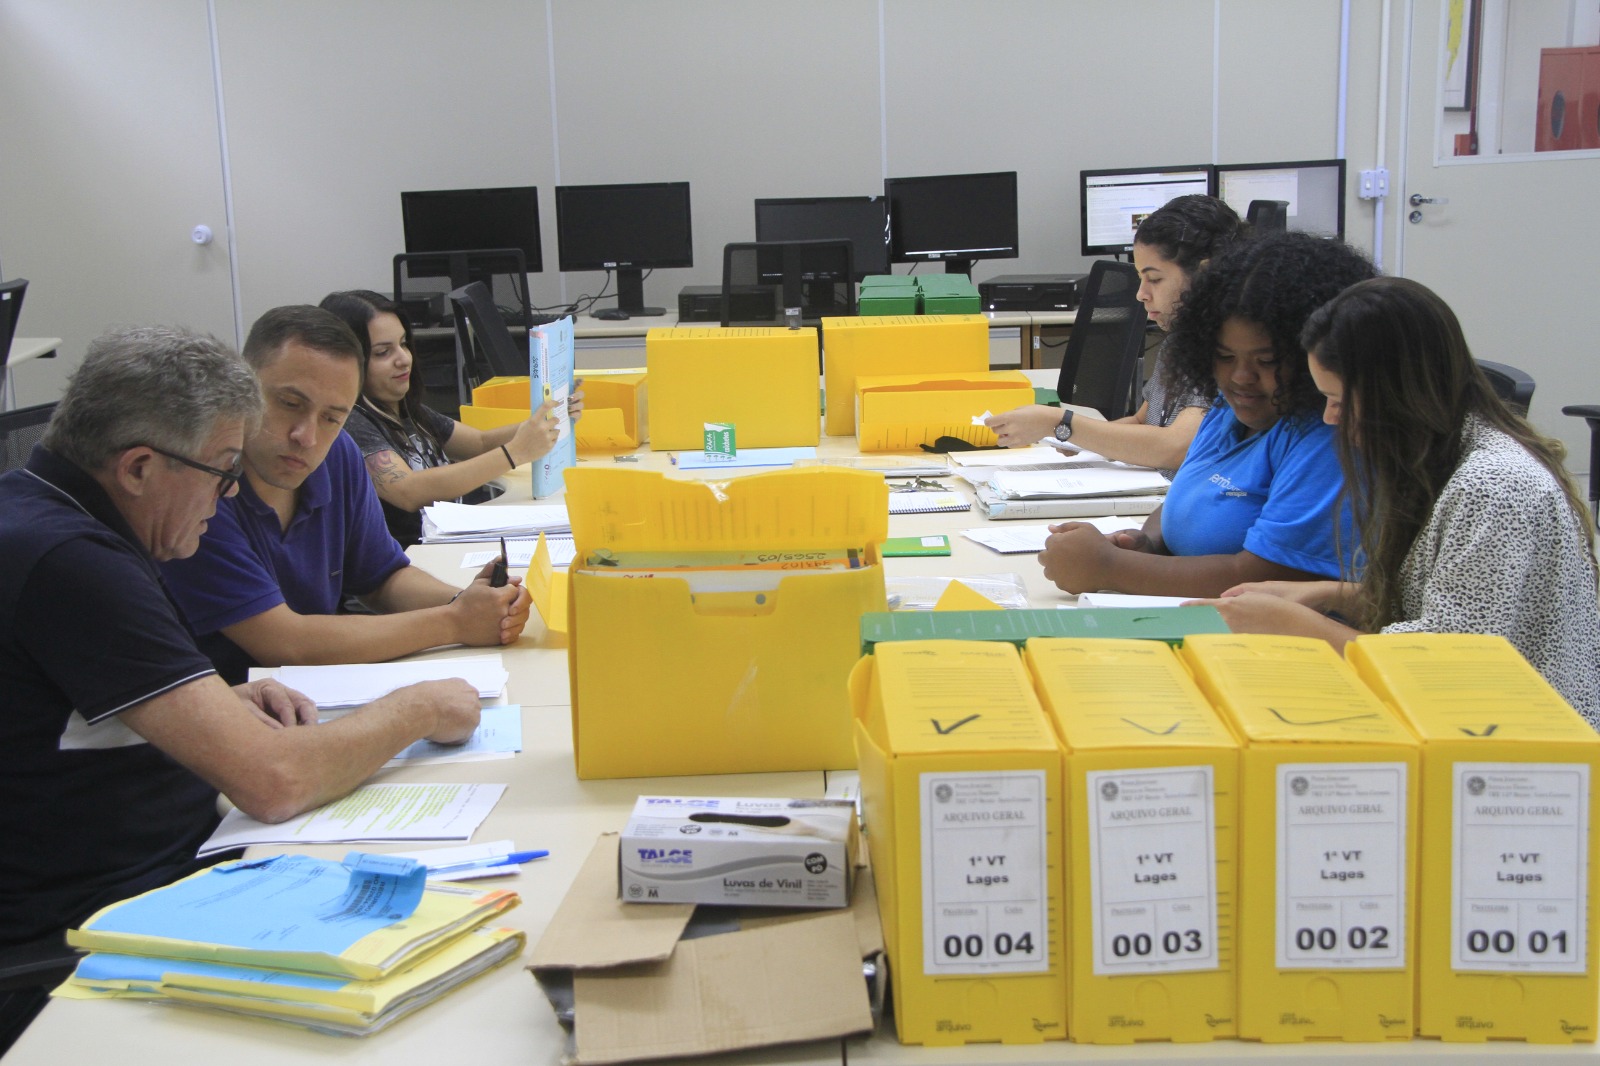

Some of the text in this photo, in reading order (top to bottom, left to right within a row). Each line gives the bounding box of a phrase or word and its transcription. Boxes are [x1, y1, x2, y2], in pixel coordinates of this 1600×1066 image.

[942, 809, 1026, 822] ARQUIVO GERAL
[1109, 806, 1192, 820] ARQUIVO GERAL
[1297, 803, 1384, 816] ARQUIVO GERAL
[1474, 805, 1564, 817] ARQUIVO GERAL
[637, 848, 693, 864] TALGE
[806, 856, 825, 865] COM
[986, 854, 1007, 866] VT
[1153, 852, 1175, 864] VT
[1341, 850, 1363, 861] VT
[1518, 853, 1541, 864] VT
[966, 874, 1010, 887] Lages
[1134, 869, 1178, 884] Lages
[1320, 868, 1365, 881] Lages
[1496, 871, 1543, 884] Lages
[723, 878, 802, 889] Luvas de Vinil
[648, 888, 659, 897] M
[943, 931, 1035, 958] 00 04
[1111, 929, 1202, 957] 00 03
[1295, 926, 1389, 951] 00 02
[1467, 929, 1567, 954] 00 01
